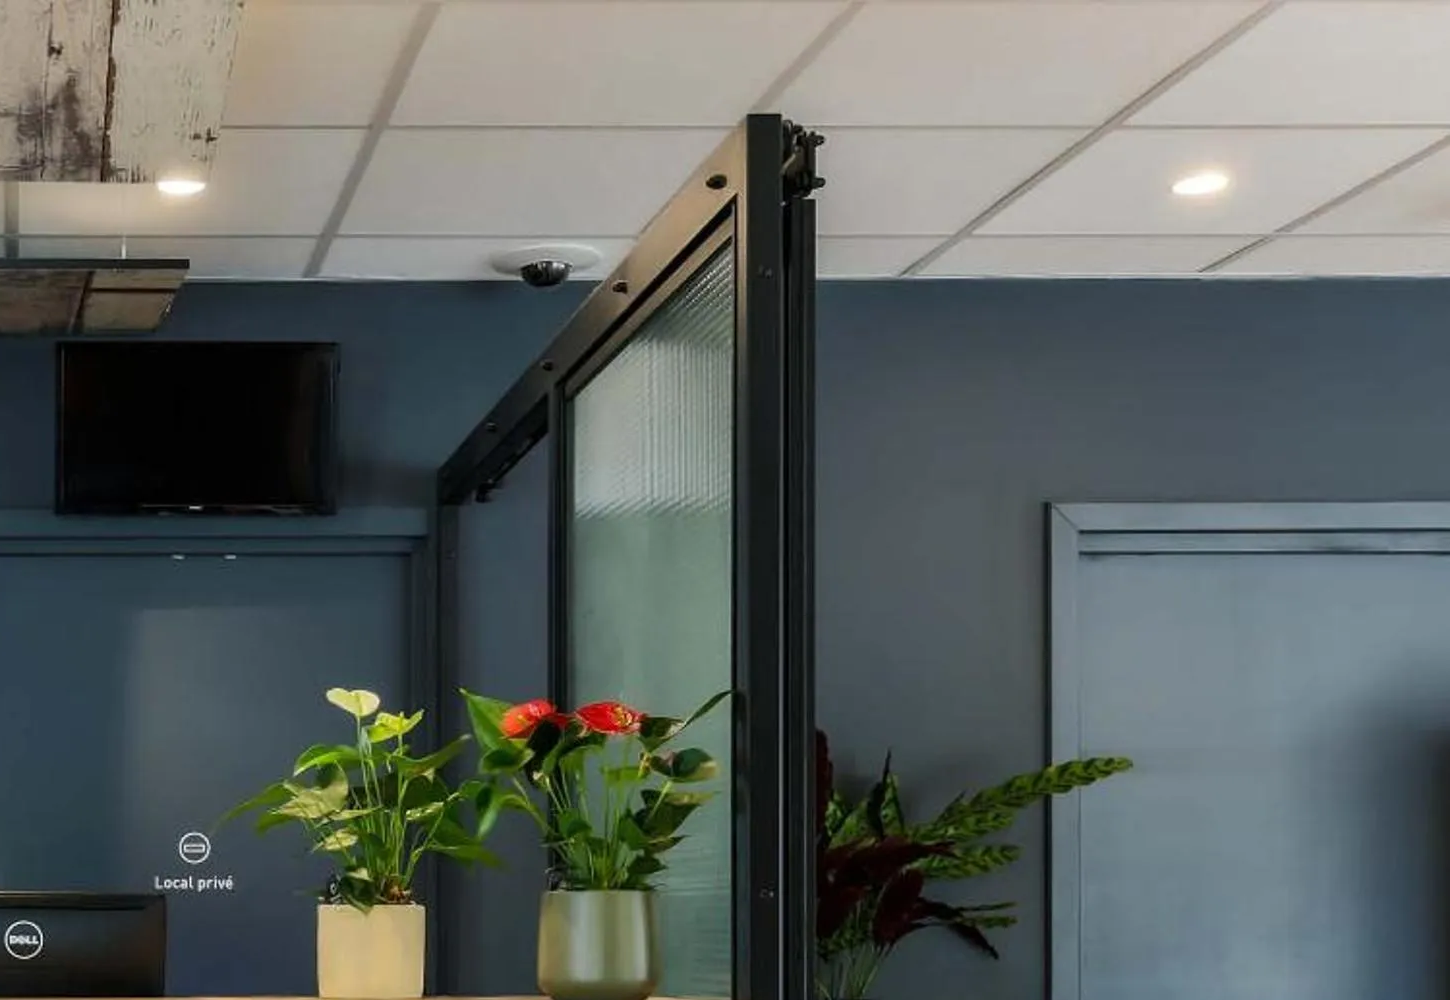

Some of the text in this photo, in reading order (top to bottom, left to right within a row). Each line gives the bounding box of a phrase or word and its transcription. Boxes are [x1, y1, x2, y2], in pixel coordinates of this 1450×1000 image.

[154, 875, 234, 892] Local privé
[9, 934, 39, 945] DELL
